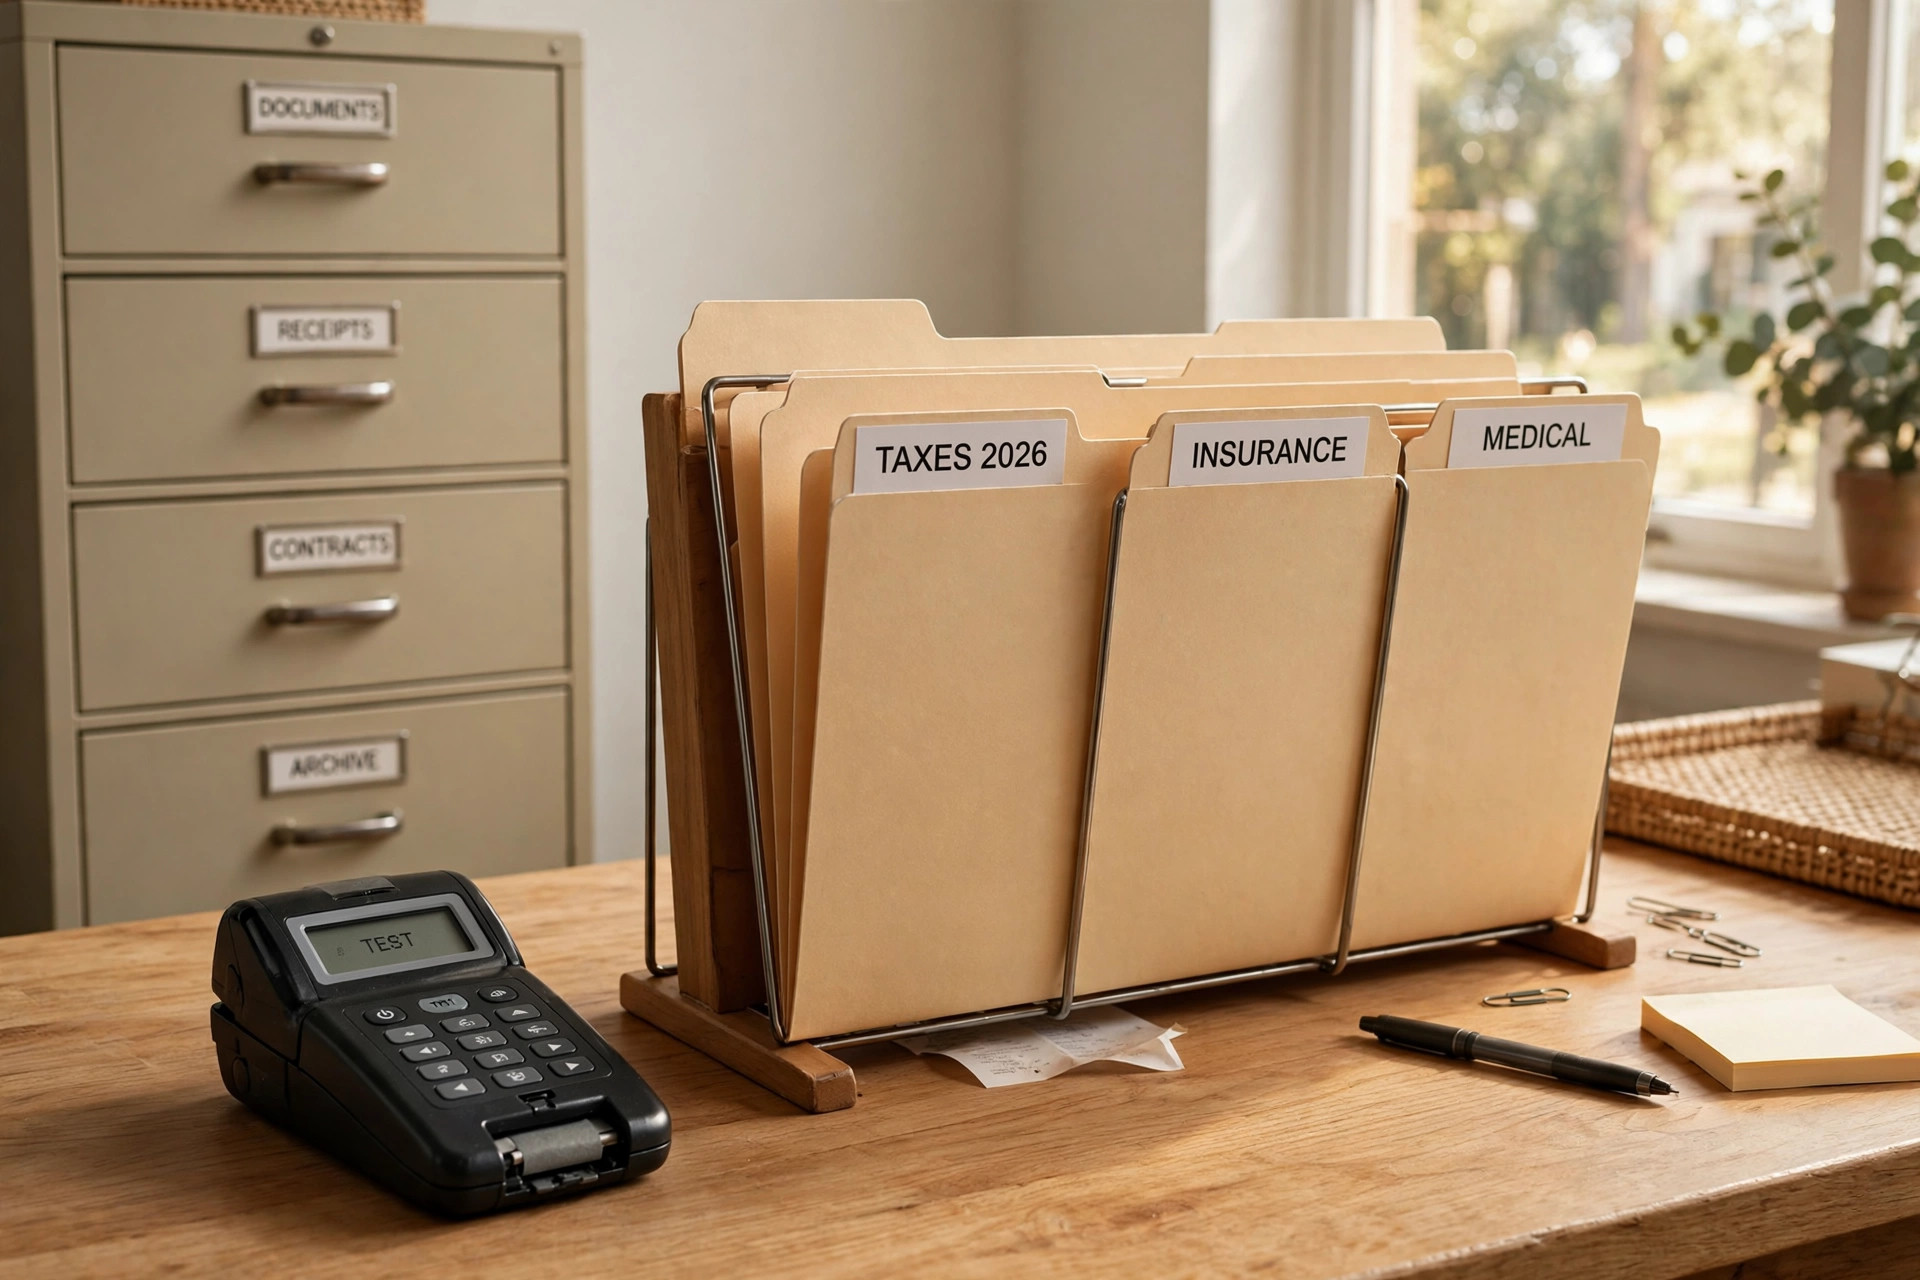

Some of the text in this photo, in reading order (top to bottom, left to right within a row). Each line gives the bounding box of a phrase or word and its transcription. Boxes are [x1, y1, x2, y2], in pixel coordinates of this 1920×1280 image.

[259, 97, 380, 121] DOCUMENTS
[277, 318, 374, 341] RECEIPTS
[1483, 422, 1591, 451] MEDICAL
[875, 440, 1047, 473] TAXES 2026
[1192, 436, 1348, 468] INSURANCE
[269, 532, 390, 561] CONTRACTS
[289, 749, 379, 778] ARCHIVE
[360, 932, 414, 954] TEST
